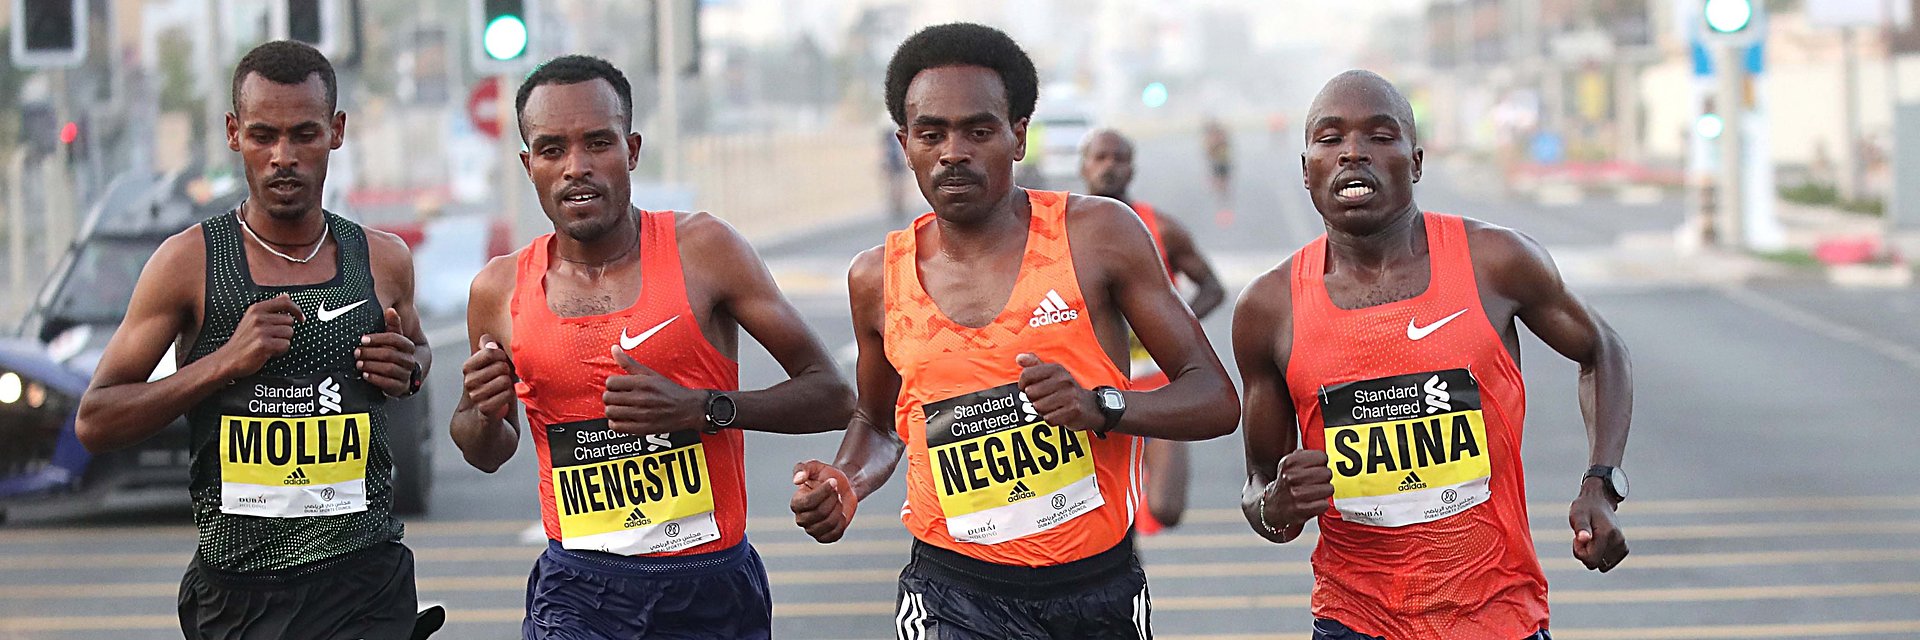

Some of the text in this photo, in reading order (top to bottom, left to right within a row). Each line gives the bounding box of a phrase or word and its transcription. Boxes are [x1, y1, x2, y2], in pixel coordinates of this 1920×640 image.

[1029, 309, 1078, 328] adidas
[254, 384, 314, 399] Standard
[1354, 383, 1419, 404] Standard
[248, 400, 315, 414] Chartered
[953, 393, 1015, 420] Standard
[1352, 400, 1421, 420] Chartered
[951, 409, 1020, 437] Chartered
[229, 418, 362, 466] MOLLA
[576, 429, 631, 445] Stand
[1334, 414, 1481, 478] SAINA
[574, 438, 642, 461] Chartered
[937, 424, 1085, 496] NEGASA
[559, 448, 702, 516] MENGSTU
[1397, 482, 1427, 492] adidas
[238, 496, 267, 504] DUBAI
[1007, 490, 1036, 503] adidas
[623, 518, 652, 529] adidas
[967, 523, 996, 536] DUBAI
